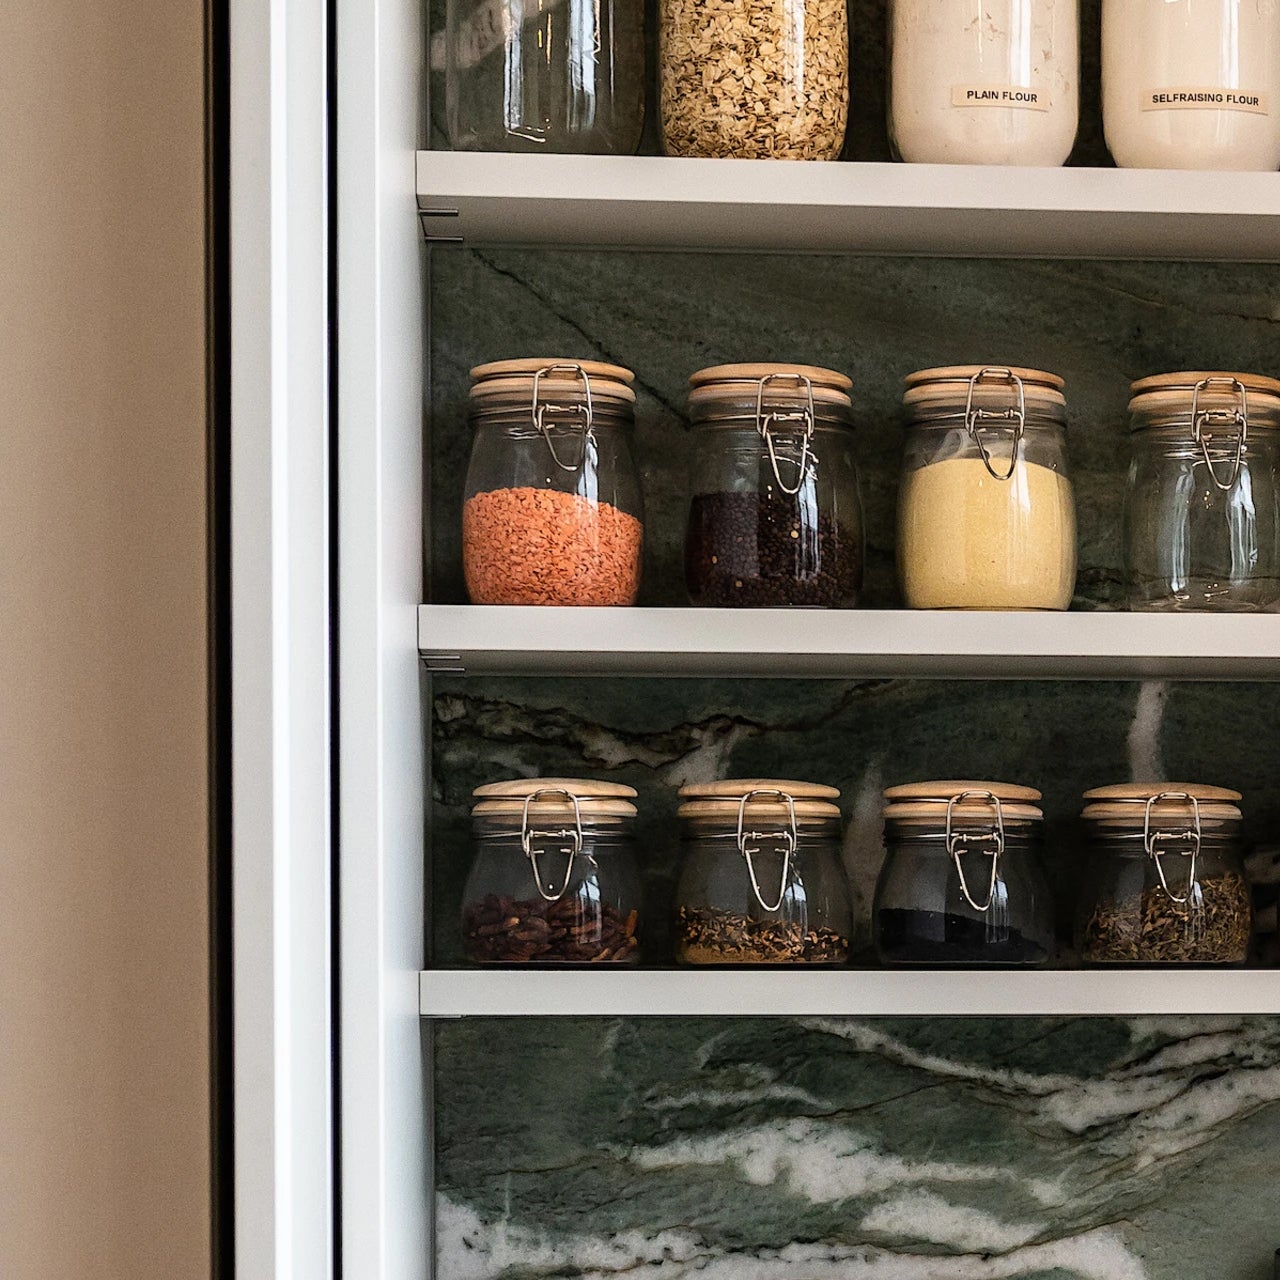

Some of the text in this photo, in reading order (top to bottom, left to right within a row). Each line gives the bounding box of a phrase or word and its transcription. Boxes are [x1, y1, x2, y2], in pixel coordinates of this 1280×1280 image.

[966, 90, 1038, 103] PLAIN FLOUR
[1152, 93, 1259, 106] SELFRAISING FLOUR
